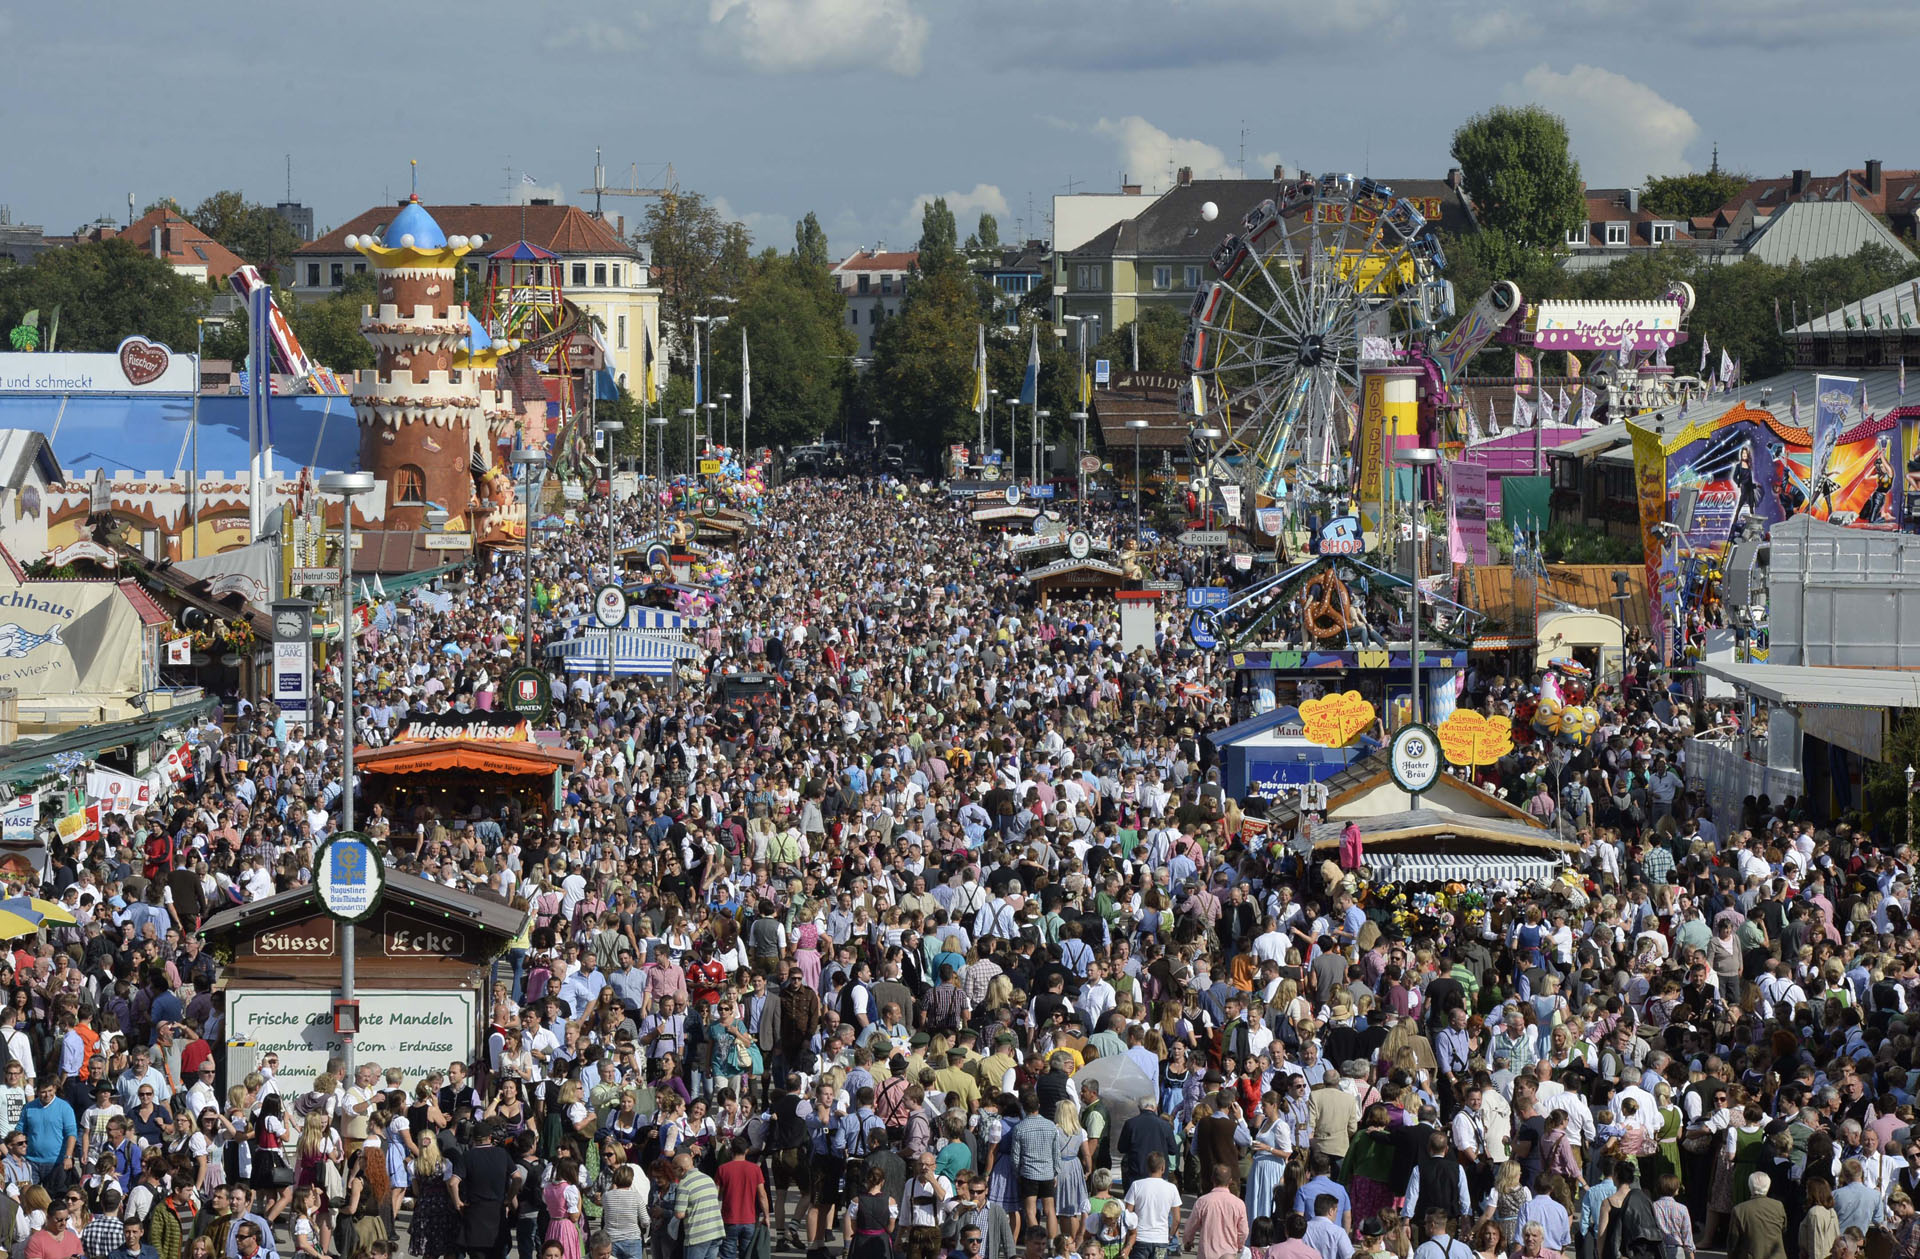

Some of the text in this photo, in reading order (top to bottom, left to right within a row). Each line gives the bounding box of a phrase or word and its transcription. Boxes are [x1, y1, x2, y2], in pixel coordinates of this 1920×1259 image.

[128, 353, 158, 372] Rischart
[7, 373, 93, 388] und schmeckt
[1367, 378, 1382, 485] TOP SPIN
[1033, 487, 1040, 496] U
[1140, 531, 1156, 540] WC
[1191, 533, 1223, 542] Polizei
[1320, 540, 1363, 554] SHOP
[293, 572, 339, 580] 26 Notruf-SOS
[1192, 591, 1203, 605] U
[0, 590, 75, 620] chhaus
[278, 648, 303, 657] LANG
[14, 660, 62, 679] Wies'n
[407, 721, 515, 739] Heisse Nüsse
[394, 761, 433, 771] Heisse Nüsse
[483, 761, 522, 771] Heisse Nüsse
[1402, 761, 1430, 770] Hacker
[1405, 770, 1426, 778] Bräu
[4, 815, 33, 827] KÄSE
[260, 932, 330, 951] Süsse
[390, 930, 454, 951] Ecke
[248, 1012, 299, 1025] Frische
[389, 1012, 453, 1025] Mandeln
[400, 1041, 453, 1052] Erdnüsse
